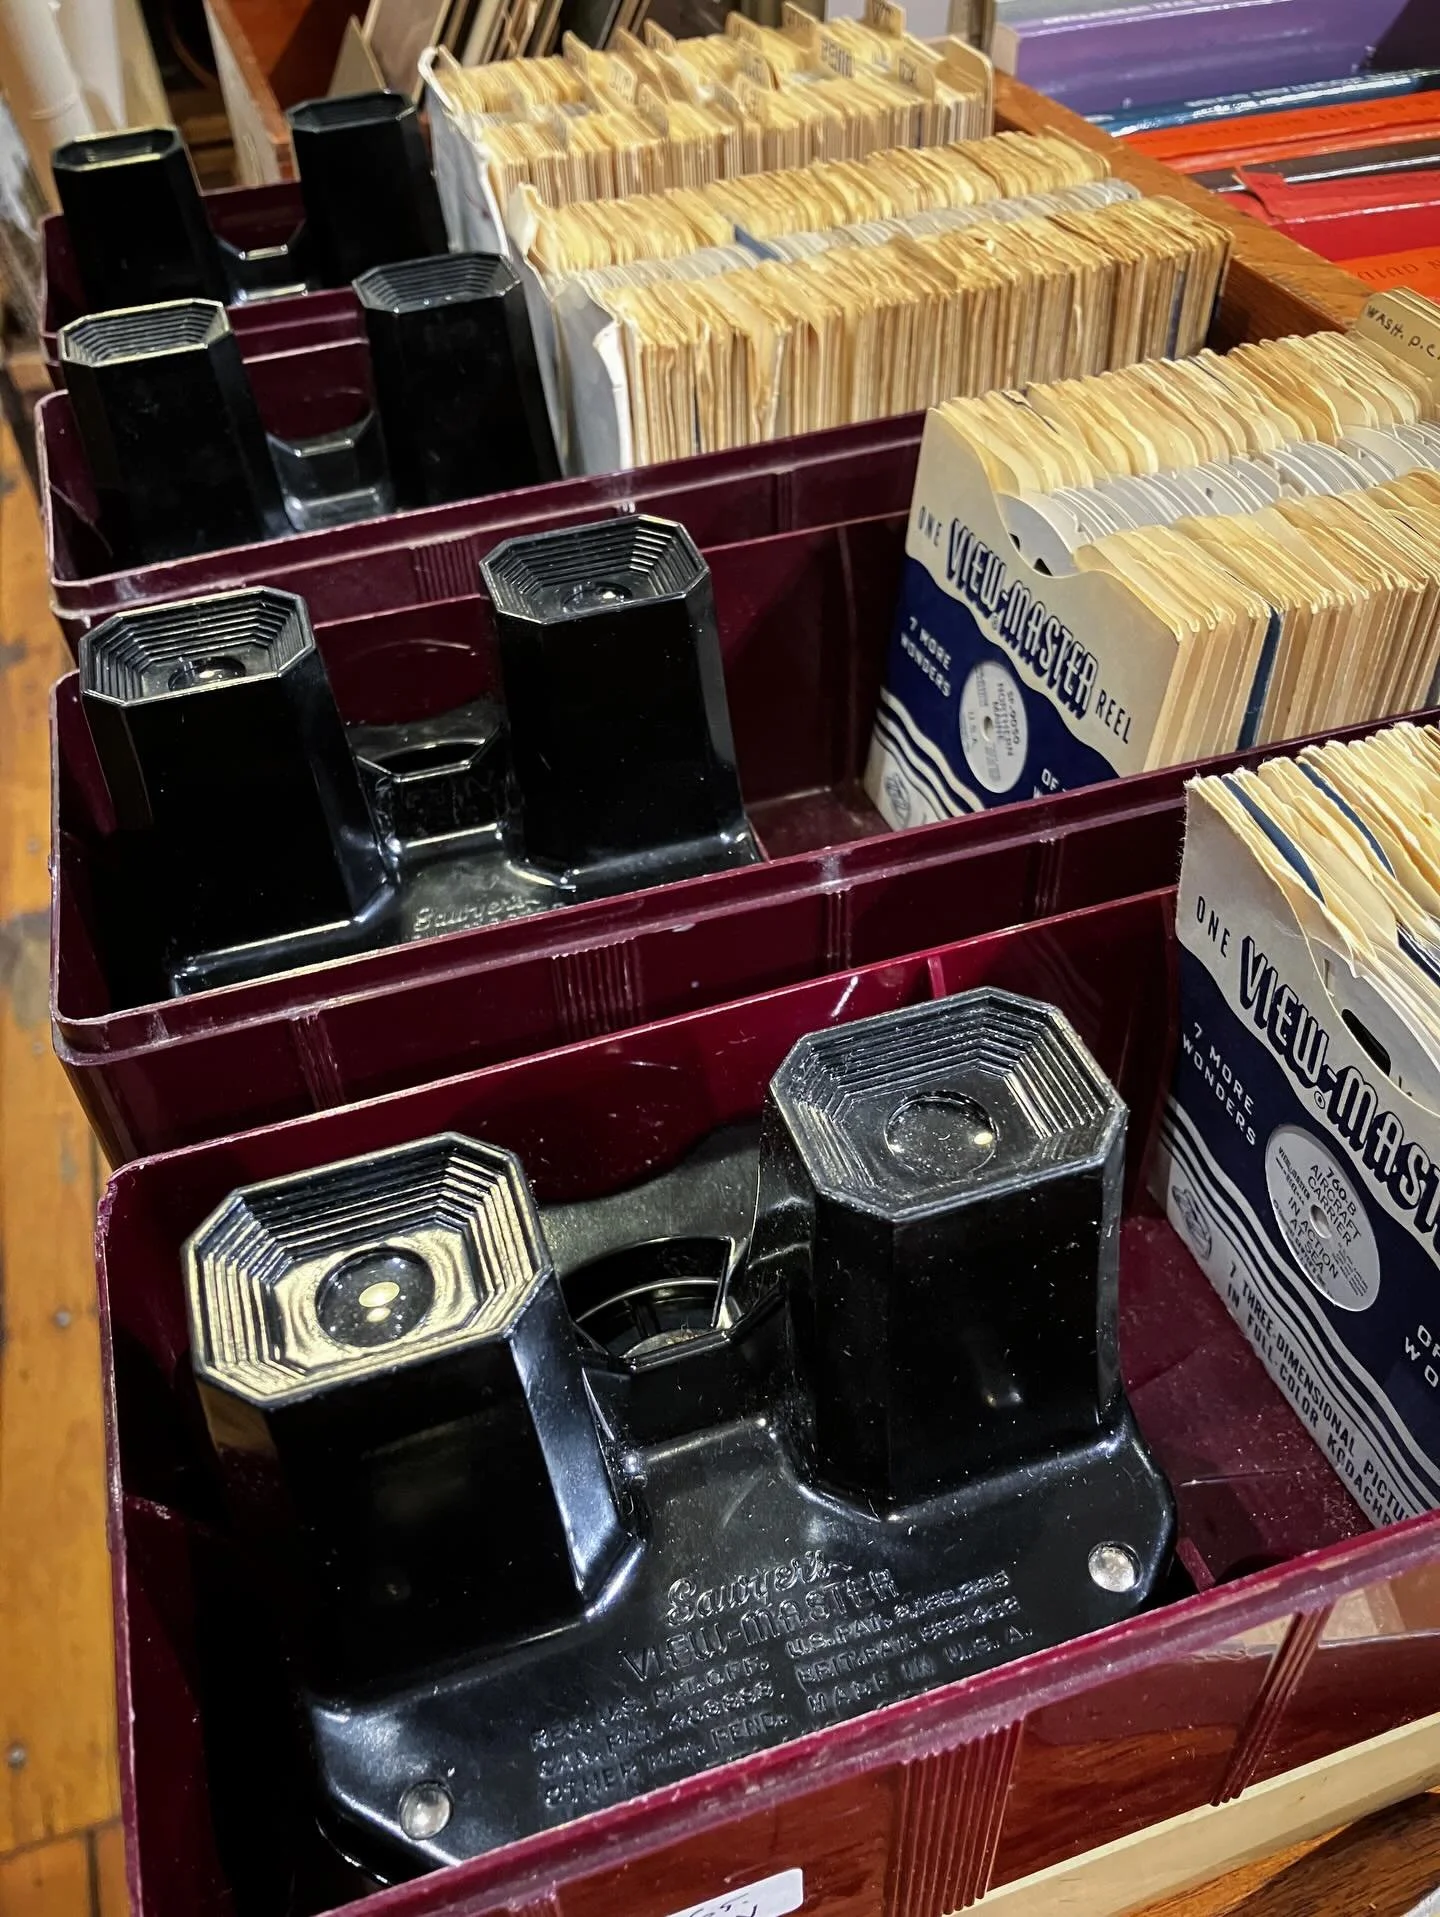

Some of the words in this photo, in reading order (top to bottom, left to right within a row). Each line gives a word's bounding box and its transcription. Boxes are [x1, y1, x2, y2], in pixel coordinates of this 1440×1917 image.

[909, 616, 918, 631] 7
[920, 627, 951, 671] MORE
[919, 506, 942, 547] ONE
[946, 517, 1098, 720] VIEW-MASTER
[1095, 688, 1132, 744] REEL
[901, 632, 951, 697] WONDERS
[1197, 895, 1230, 958] ONE
[1183, 1033, 1256, 1146] WONDERS
[1194, 1022, 1203, 1039] 7
[1210, 1045, 1254, 1115] MORE
[1307, 1175, 1353, 1247] CARRIER
[1310, 1164, 1362, 1242] AIRCRAFT
[1327, 1167, 1358, 1217] 760-B
[1288, 1196, 1301, 1217] IN
[1300, 1219, 1339, 1280] ACTION
[1290, 1218, 1305, 1238] AT
[1304, 1242, 1325, 1275] SEA
[1227, 1283, 1240, 1310] IN
[1247, 1314, 1319, 1428] FULL-COLOR
[1242, 1279, 1355, 1457] THREE-DIMENSIONAL
[1363, 1459, 1409, 1521] PICTU
[617, 1569, 899, 1682] VIEW-MASTER
[807, 1670, 890, 1714] MADE
